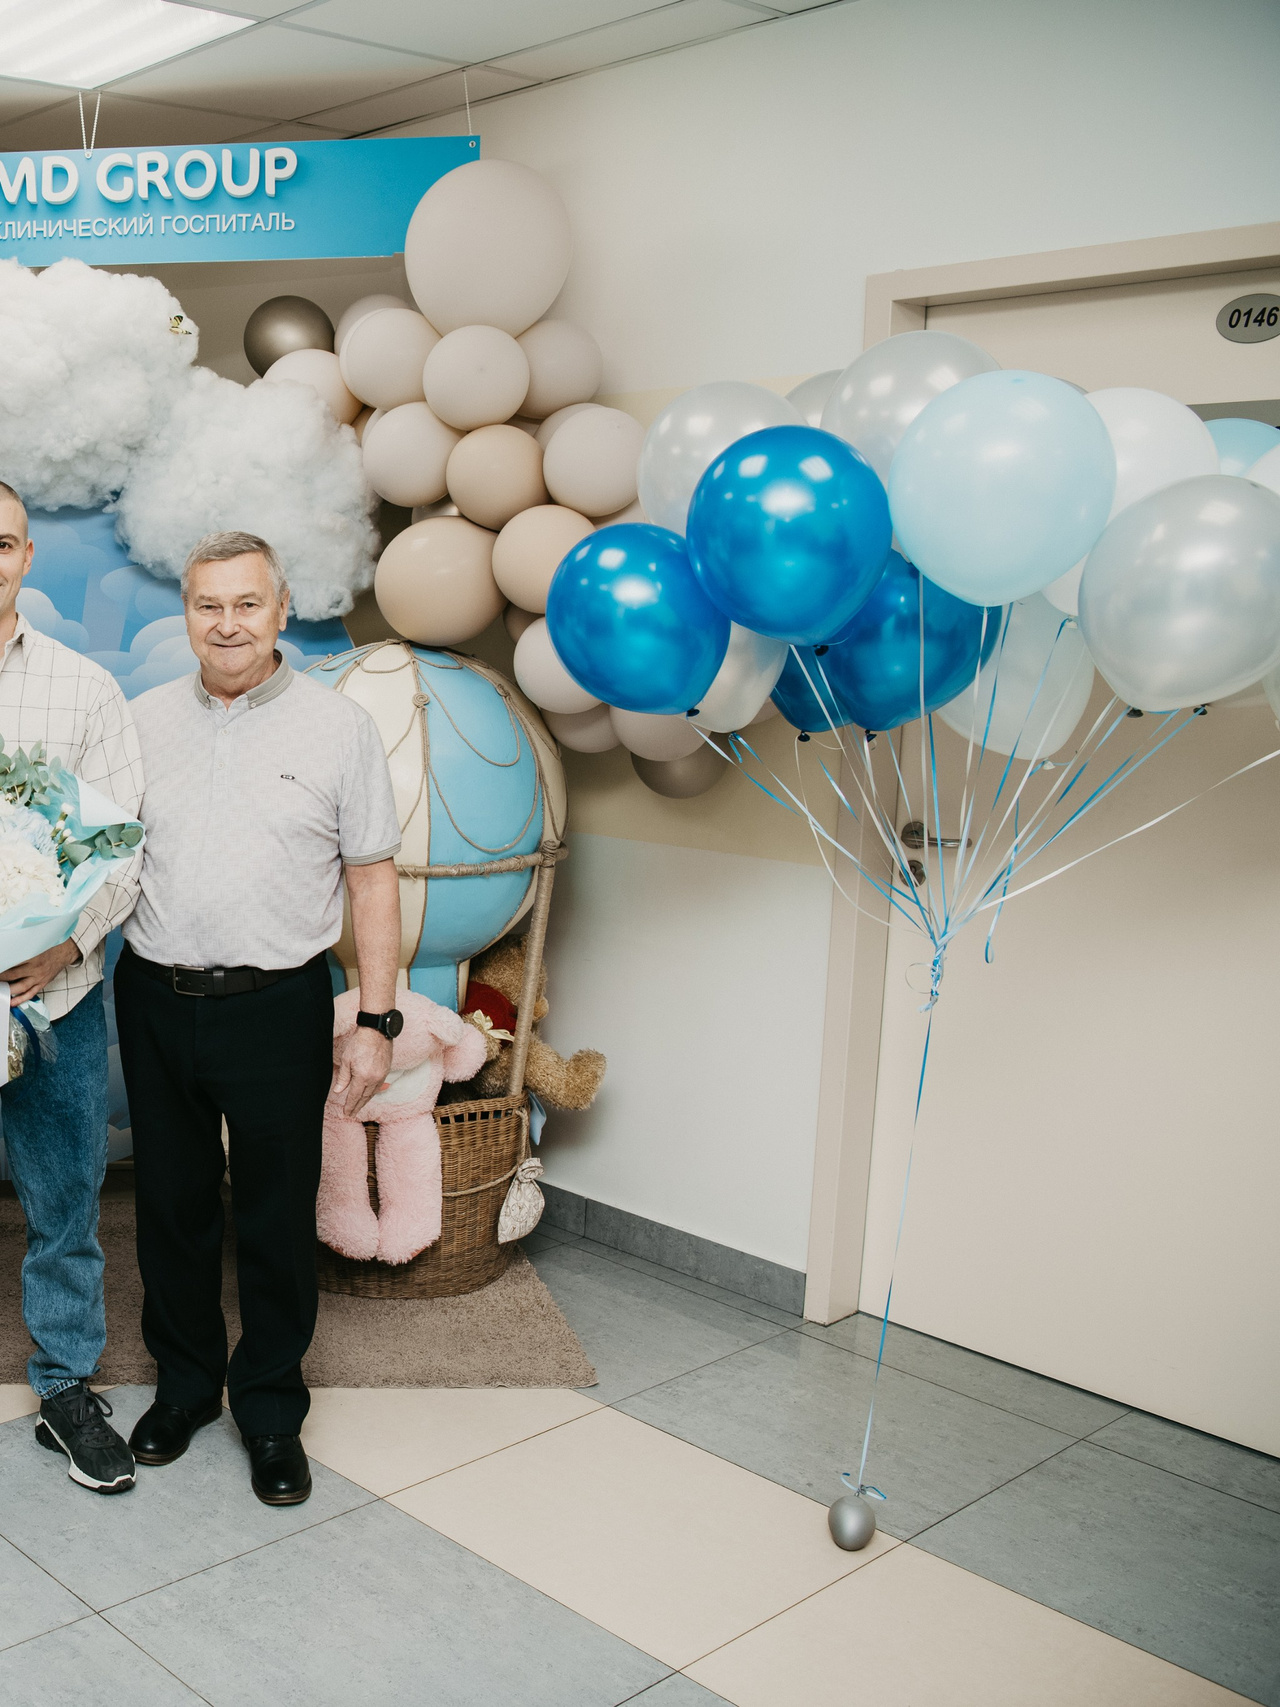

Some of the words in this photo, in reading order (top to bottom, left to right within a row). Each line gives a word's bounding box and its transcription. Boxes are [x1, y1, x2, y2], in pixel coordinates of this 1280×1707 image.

[95, 147, 298, 204] GROUP
[161, 212, 296, 235] ГОСПИТАЛЬ
[1228, 306, 1280, 329] 0146
